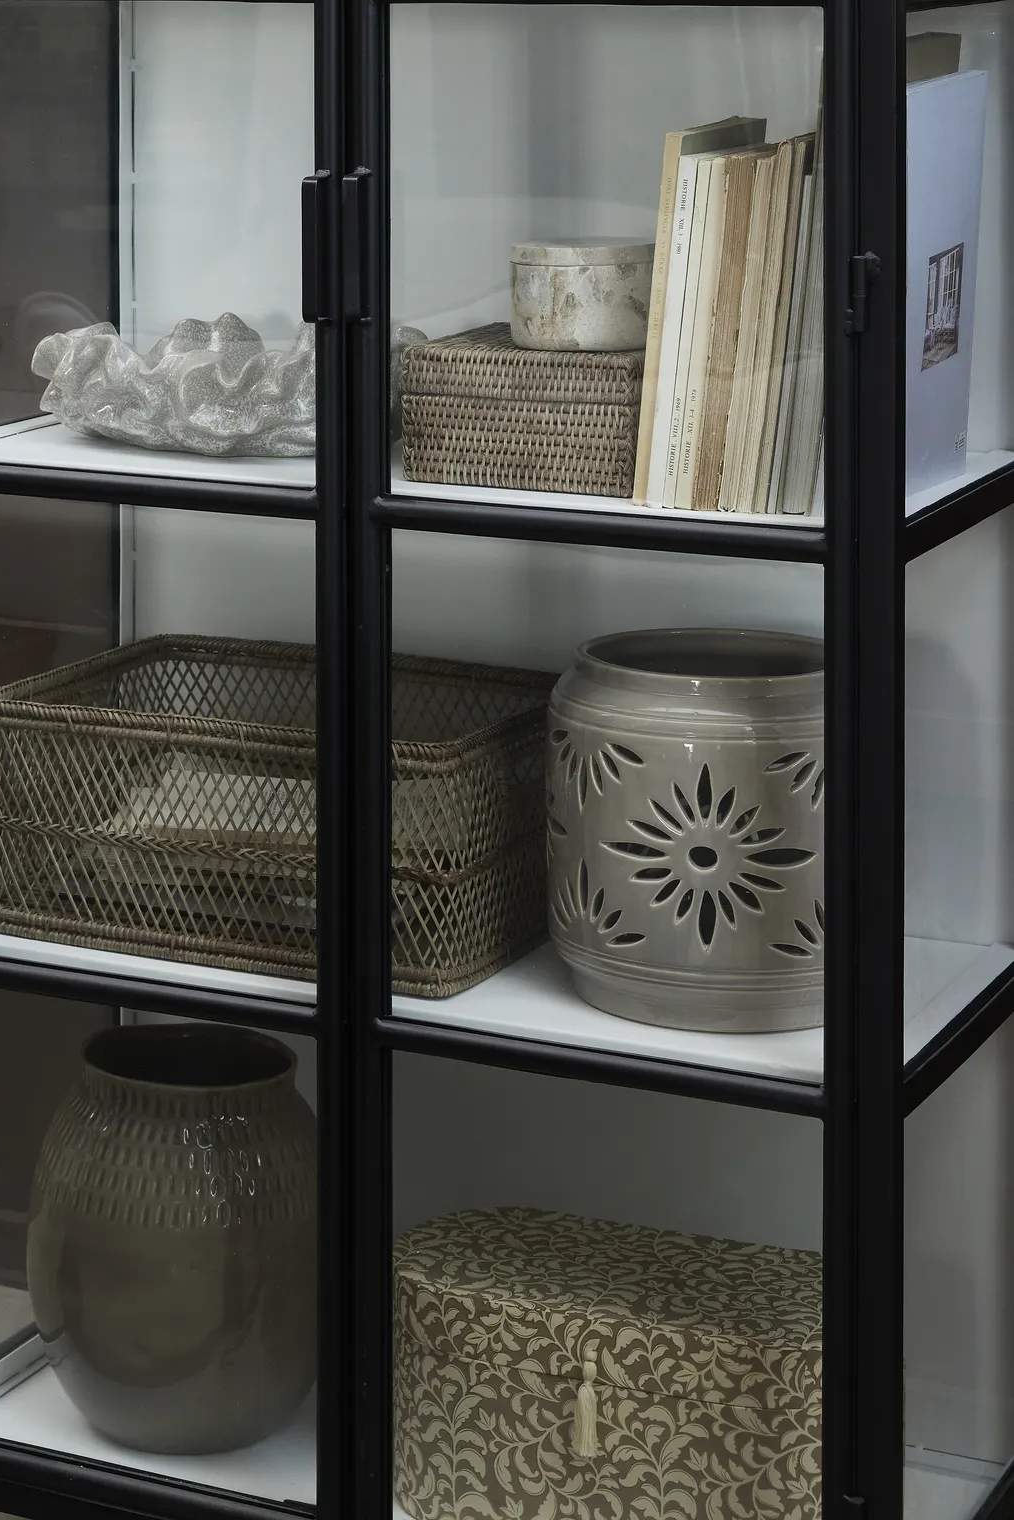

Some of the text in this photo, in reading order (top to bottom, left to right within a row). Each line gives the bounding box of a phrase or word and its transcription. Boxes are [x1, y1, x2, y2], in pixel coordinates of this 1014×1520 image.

[680, 179, 689, 211] HISTORIE
[668, 444, 676, 477] HISTORIE
[683, 441, 692, 474] HISTORIE
